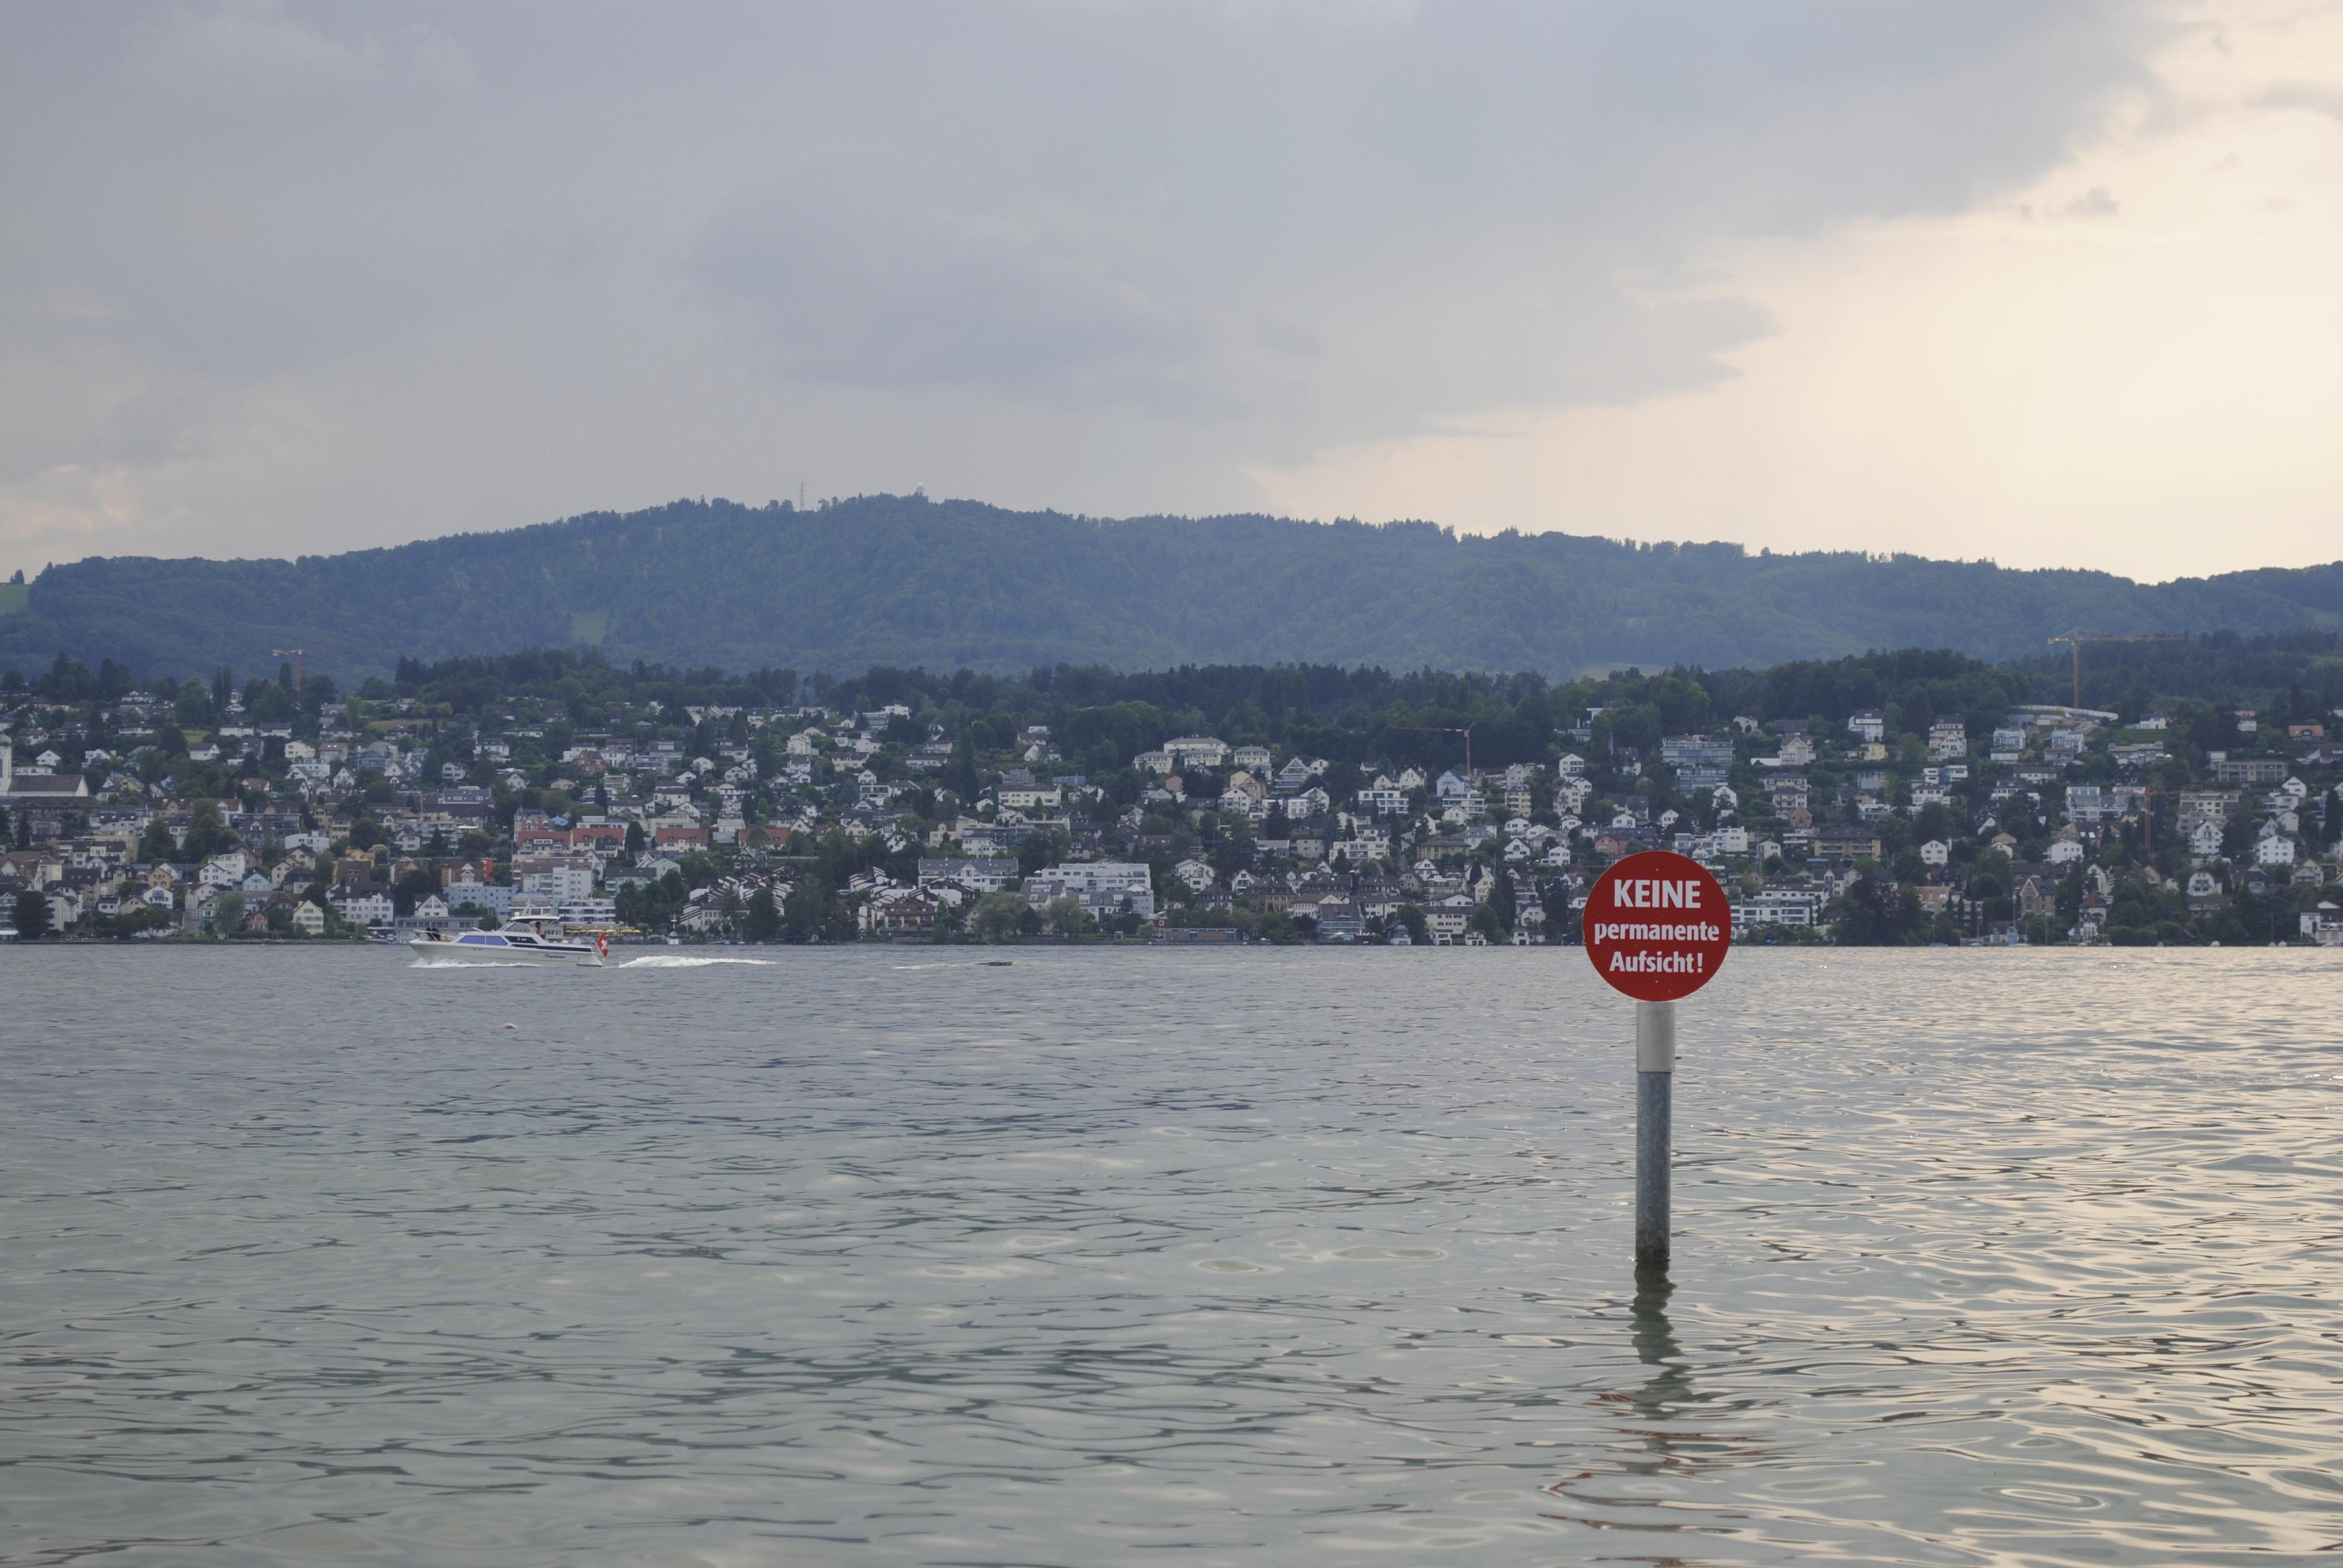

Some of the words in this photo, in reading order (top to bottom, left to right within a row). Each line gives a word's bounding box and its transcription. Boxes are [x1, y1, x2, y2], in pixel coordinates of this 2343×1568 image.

[1614, 880, 1701, 908] KEINE
[1594, 921, 1720, 944] permanente
[1610, 950, 1703, 973] Aufsicht!
